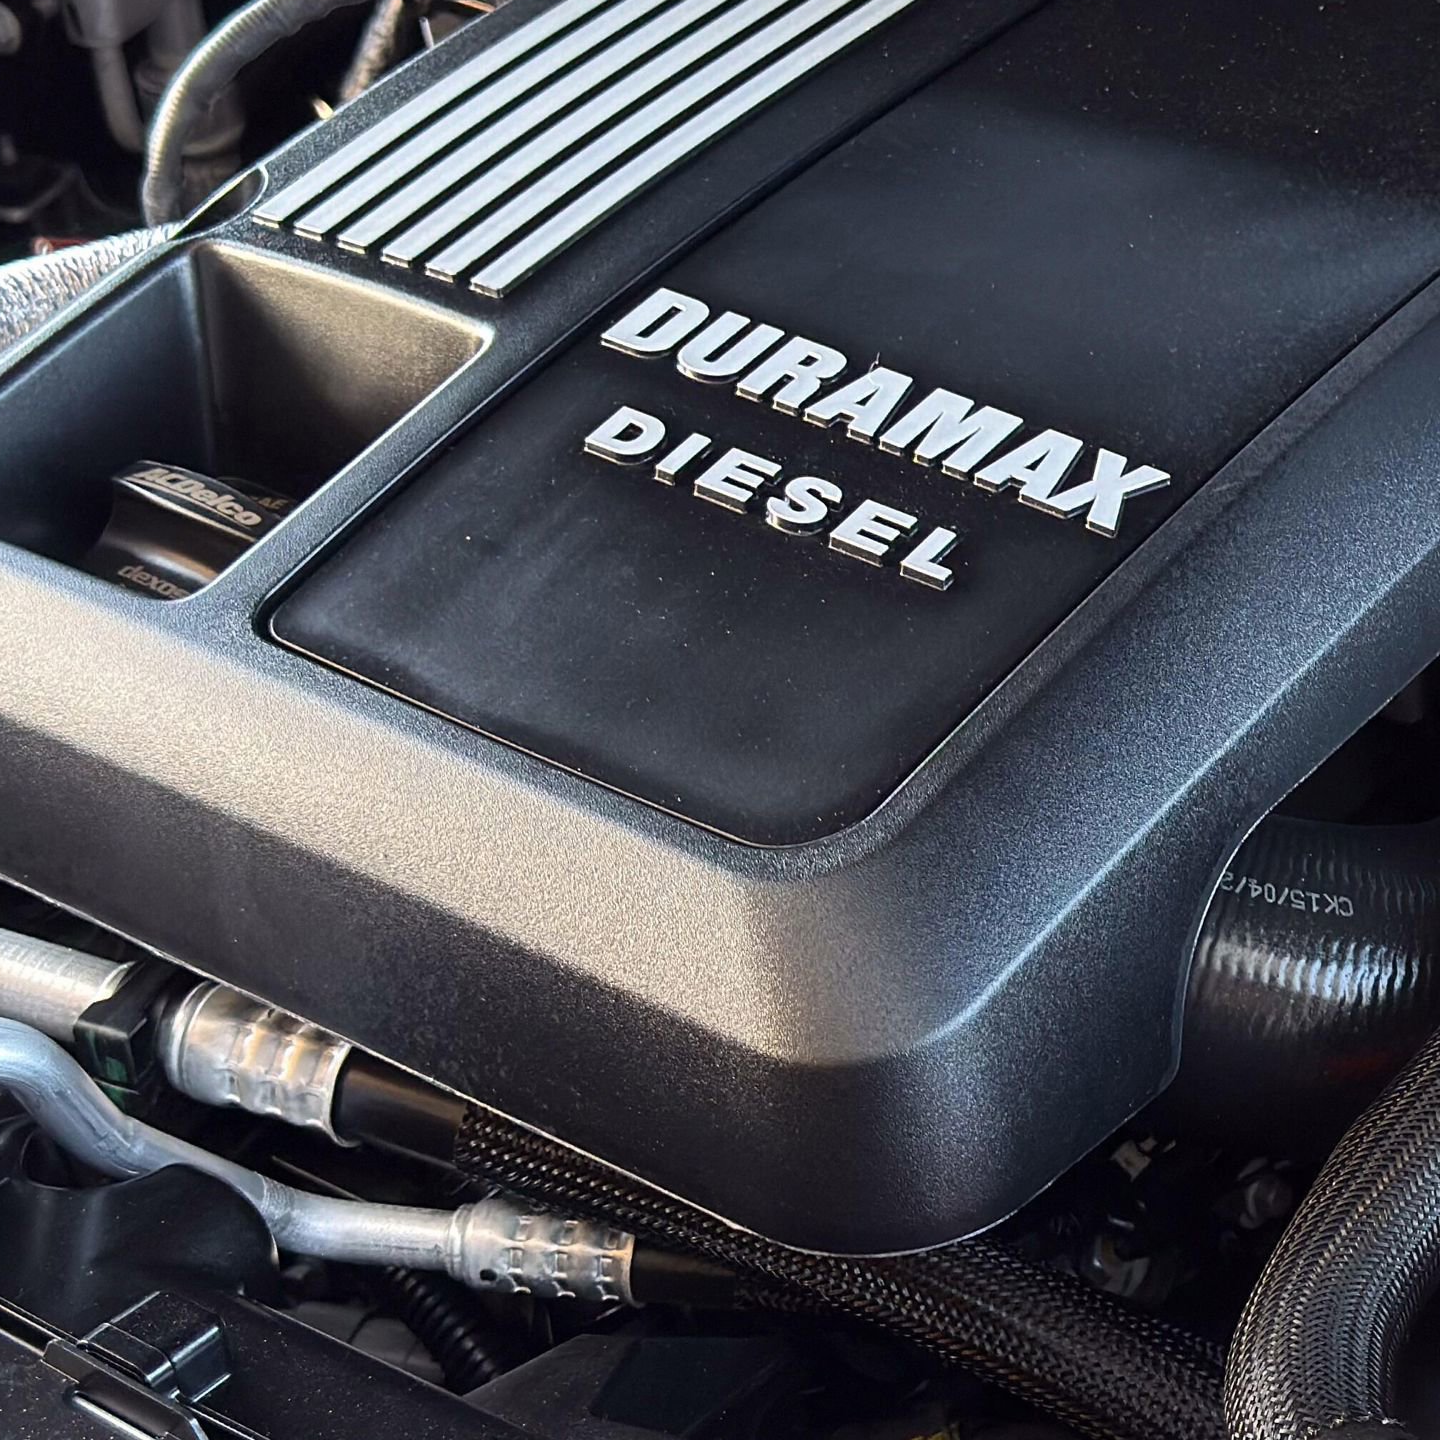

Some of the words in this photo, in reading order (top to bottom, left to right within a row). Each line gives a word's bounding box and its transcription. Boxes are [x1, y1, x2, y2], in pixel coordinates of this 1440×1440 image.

[132, 467, 262, 527] ACDelco
[584, 405, 958, 592] DIESEL
[601, 287, 1170, 539] DURAMAX
